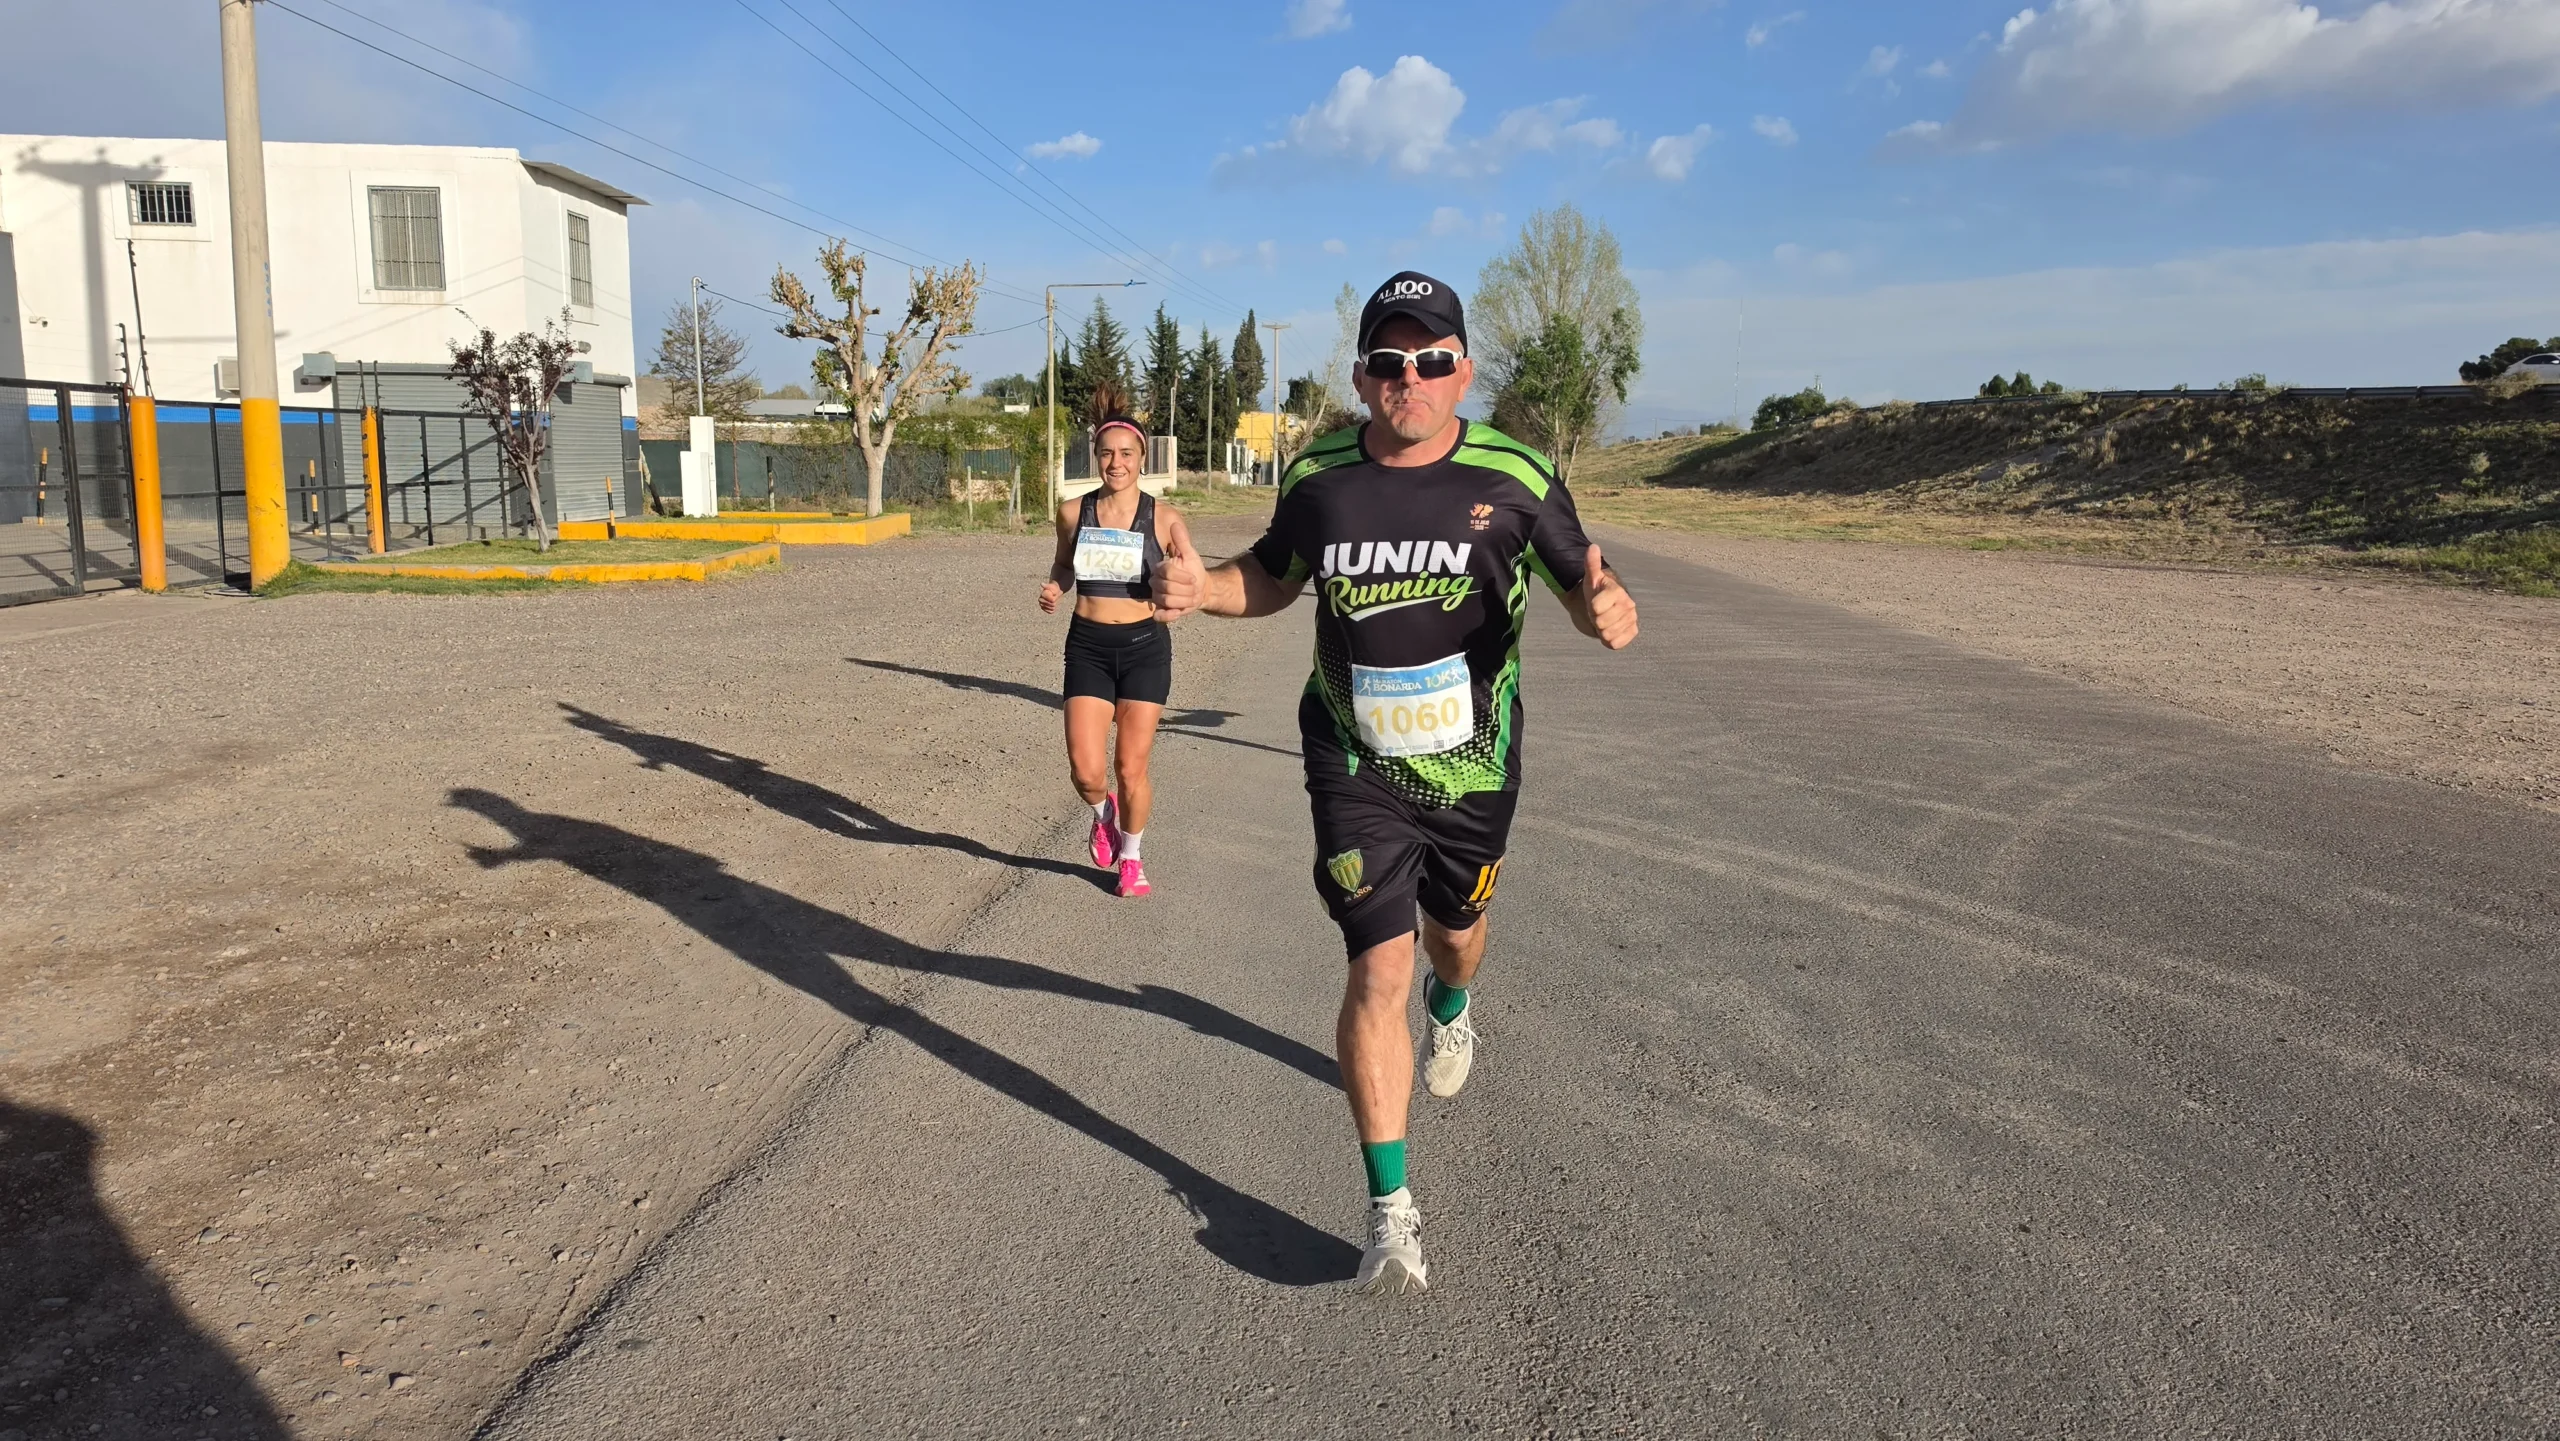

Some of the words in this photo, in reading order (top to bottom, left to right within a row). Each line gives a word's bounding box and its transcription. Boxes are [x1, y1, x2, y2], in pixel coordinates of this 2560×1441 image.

[1394, 280, 1433, 295] 100
[1082, 548, 1136, 571] 1275
[1319, 540, 1473, 579] JUNIN
[1325, 571, 1480, 619] Running
[1373, 681, 1423, 692] BONARDA
[1424, 670, 1452, 689] 10K
[1368, 696, 1460, 736] 1060
